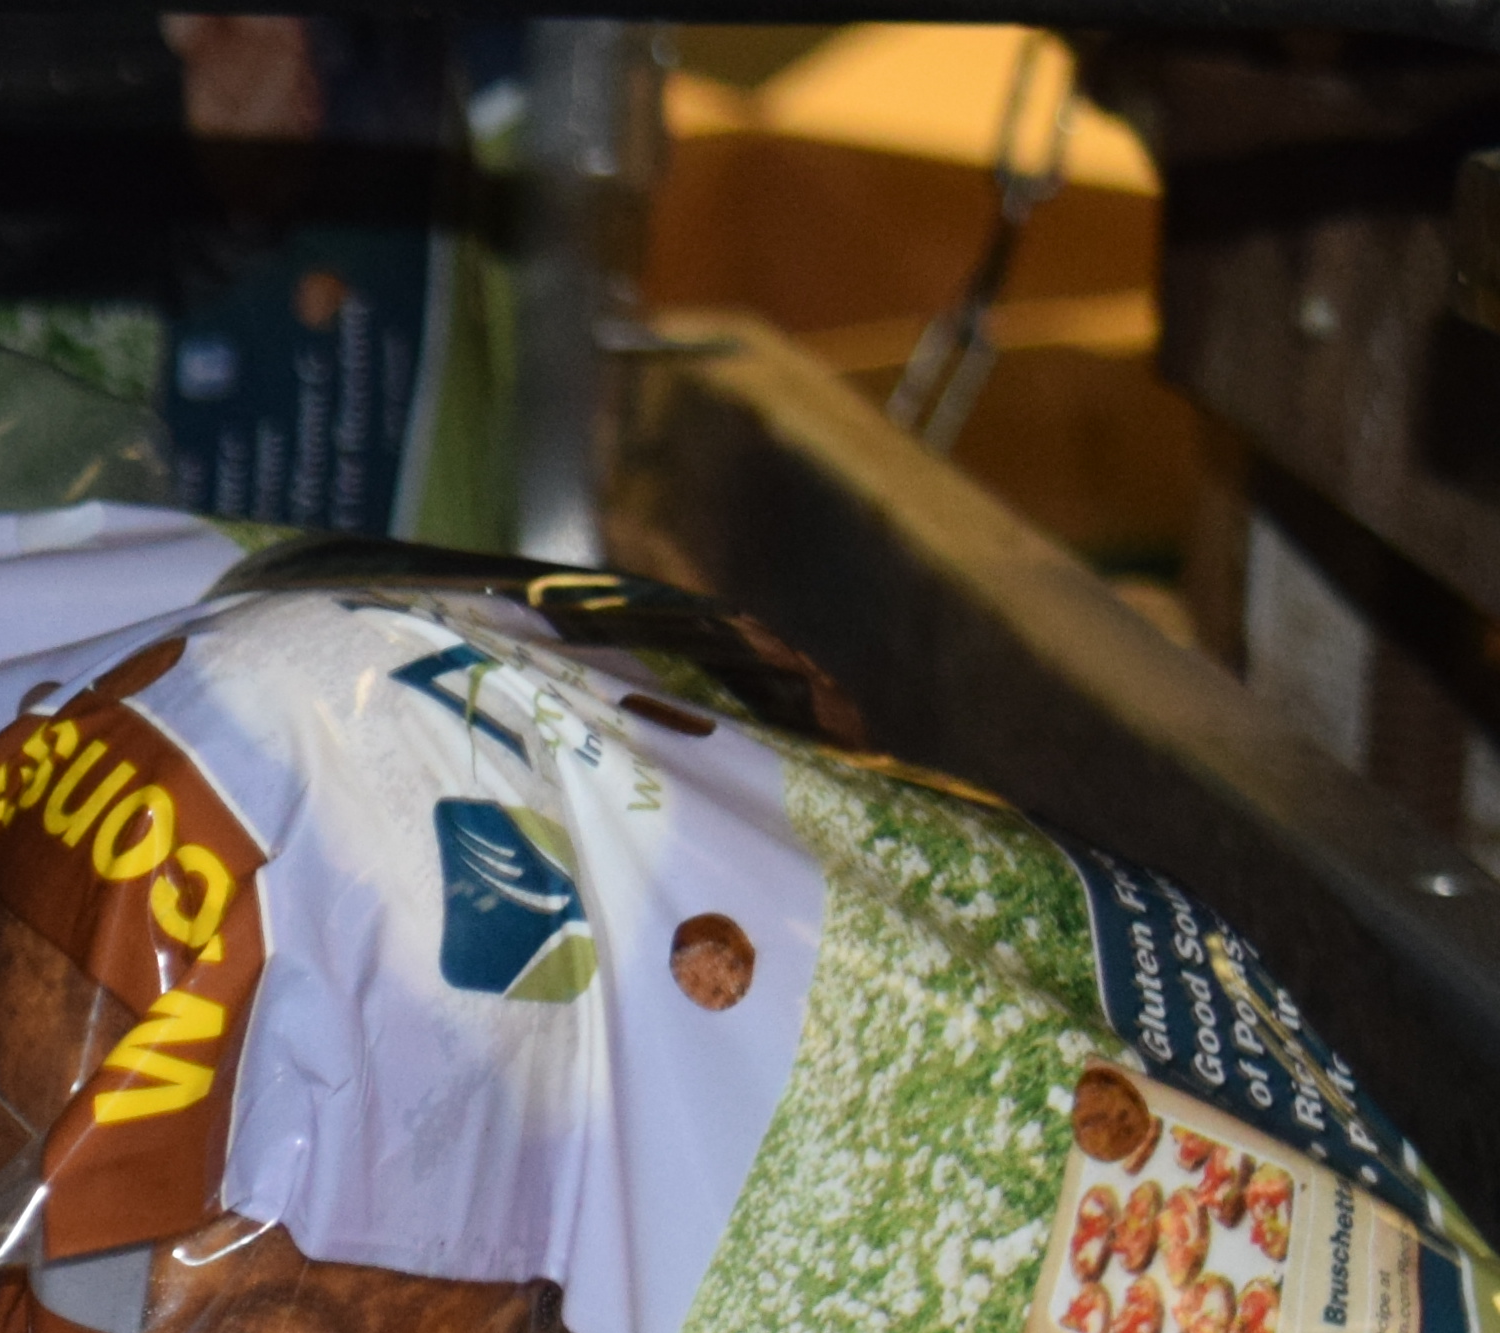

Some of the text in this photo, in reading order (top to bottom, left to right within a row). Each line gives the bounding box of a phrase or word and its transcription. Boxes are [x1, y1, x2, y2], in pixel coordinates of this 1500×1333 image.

[1132, 921, 1173, 1061] Gluten
[1181, 970, 1225, 1085] Good
[1239, 1059, 1273, 1107] of
